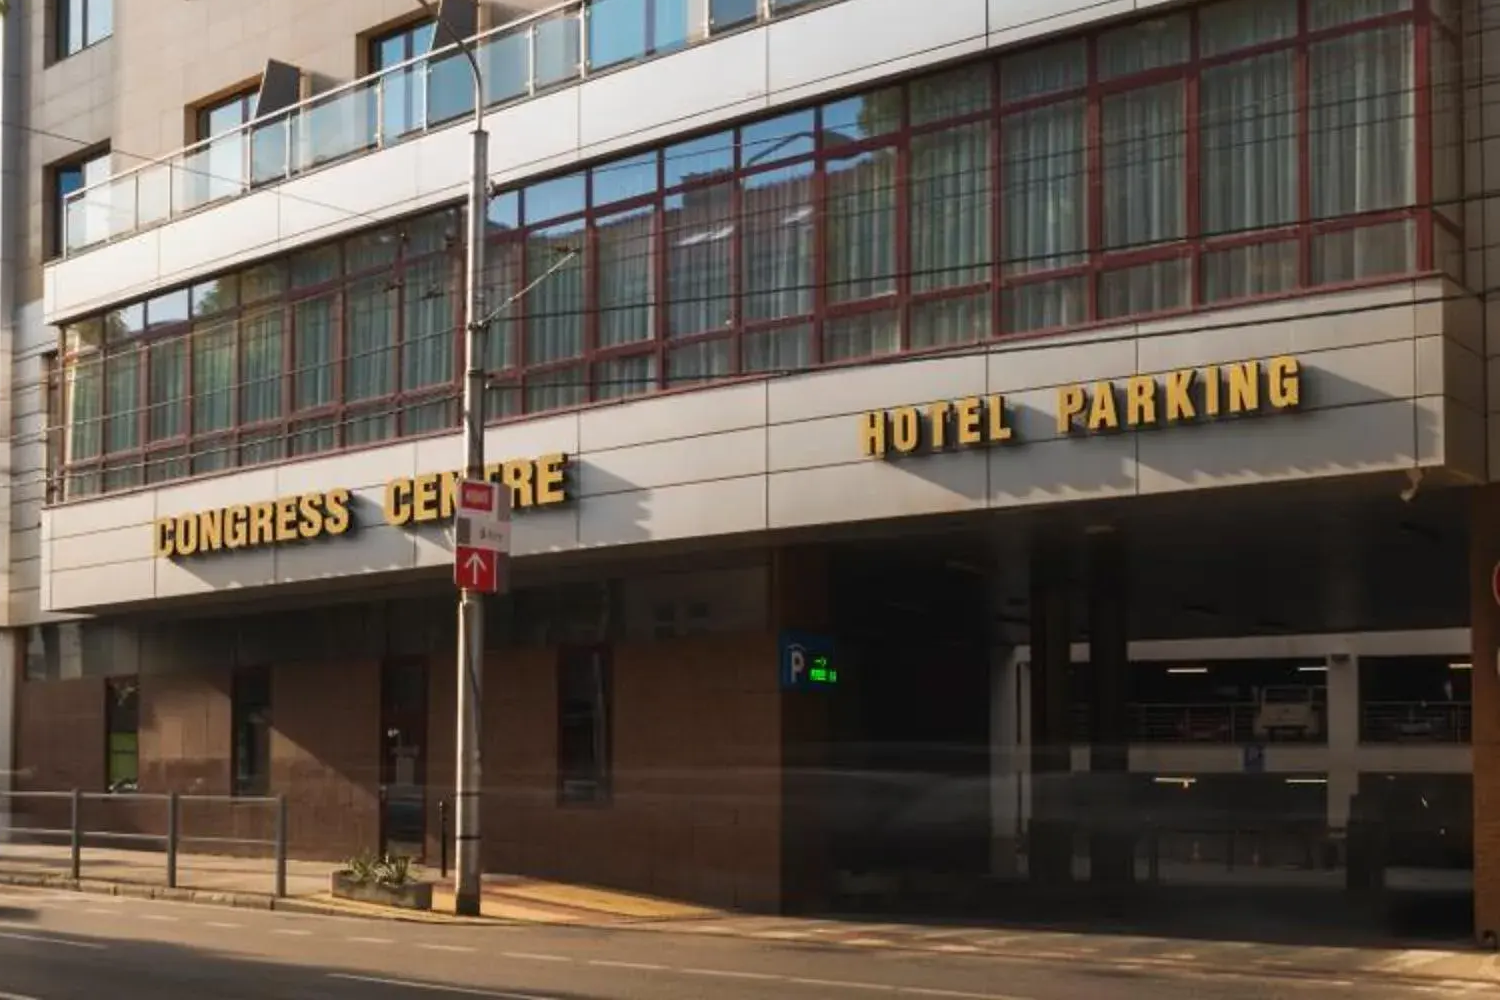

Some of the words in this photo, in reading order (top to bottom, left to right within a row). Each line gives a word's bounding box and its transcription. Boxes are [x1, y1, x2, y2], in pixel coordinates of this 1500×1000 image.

[861, 395, 1011, 459] HOTEL
[1057, 354, 1299, 433] PARKING
[155, 487, 349, 557] CONGRESS
